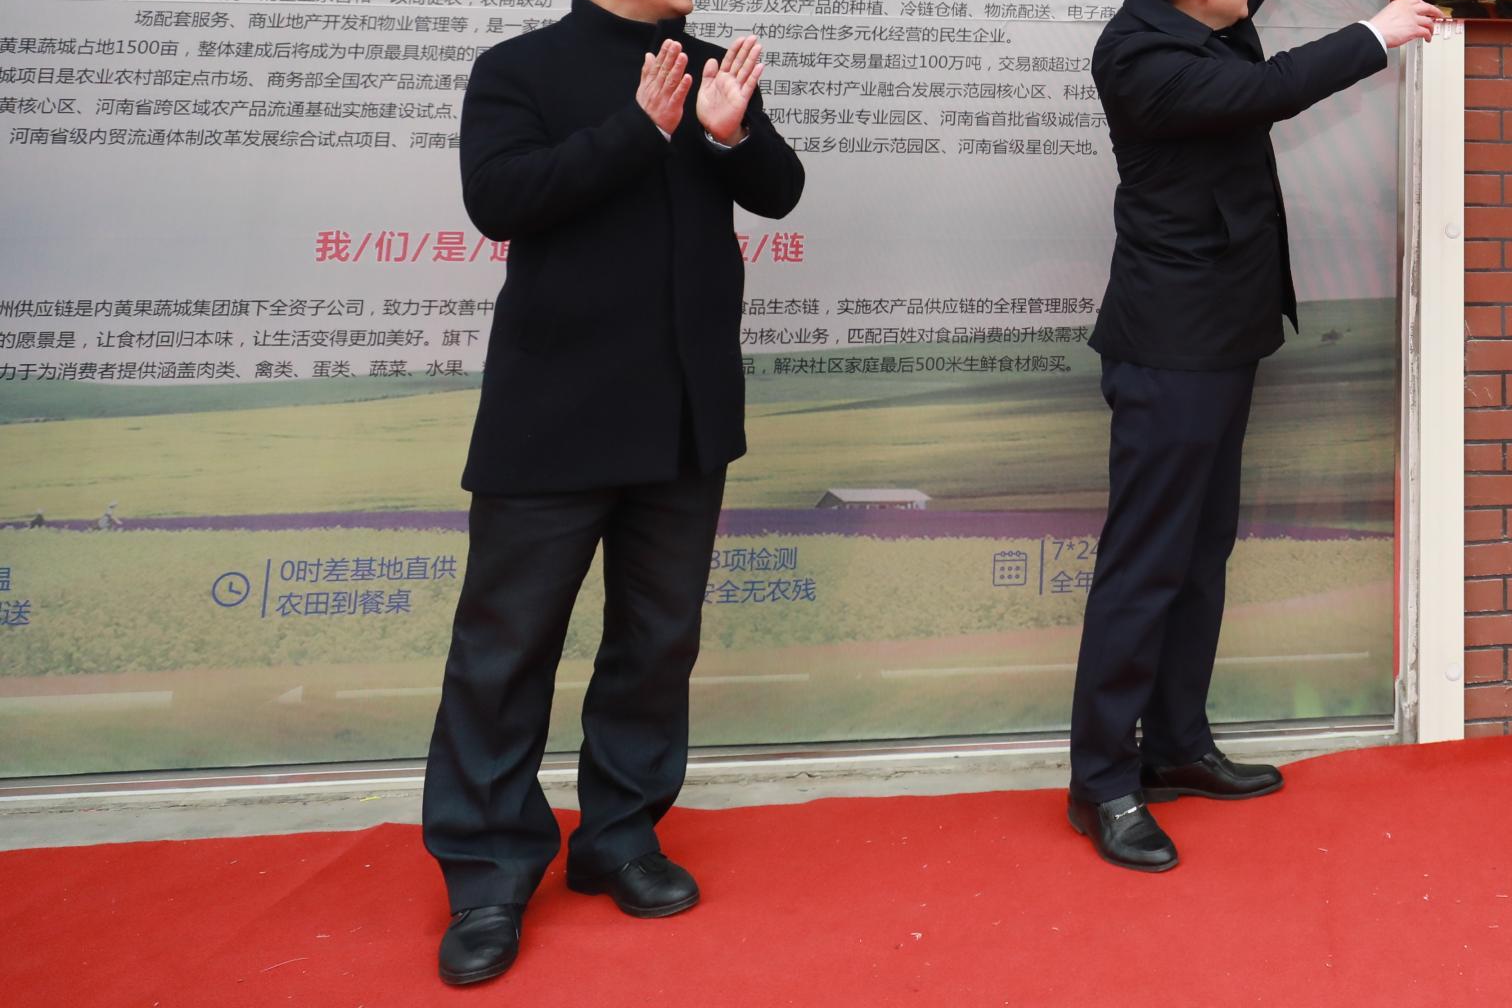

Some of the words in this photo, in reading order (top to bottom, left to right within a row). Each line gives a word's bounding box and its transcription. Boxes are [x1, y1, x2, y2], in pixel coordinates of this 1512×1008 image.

[275, 588, 413, 616] 农田到餐桌
